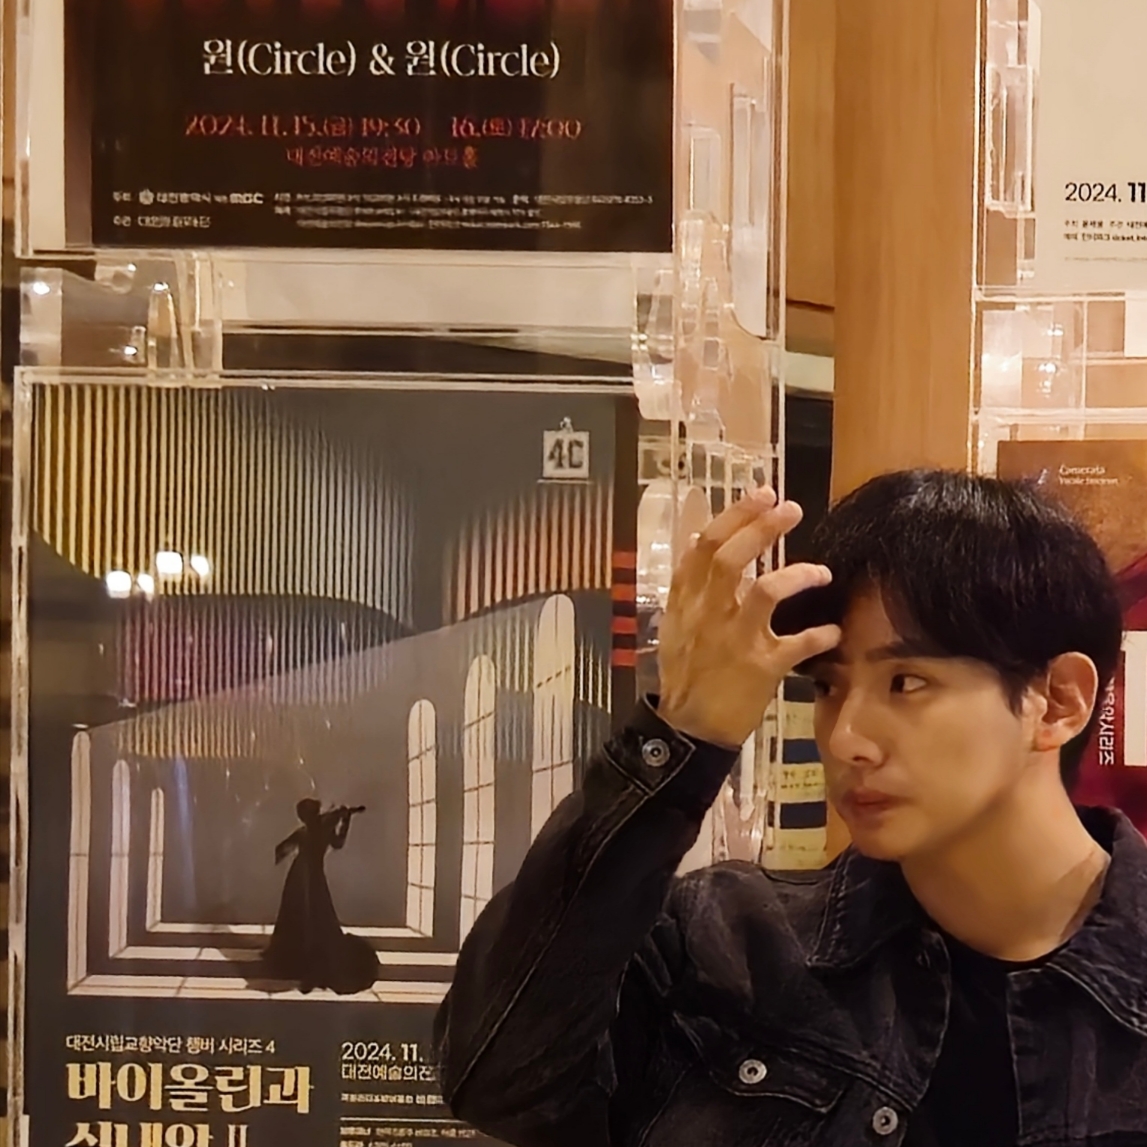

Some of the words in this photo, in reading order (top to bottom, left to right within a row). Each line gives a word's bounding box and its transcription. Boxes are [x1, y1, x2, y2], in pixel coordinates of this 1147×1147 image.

[203, 38, 356, 76] 원(Circle)
[369, 44, 396, 75] &
[406, 40, 561, 79] 원(Circle)
[1064, 182, 1123, 203] 2024.
[65, 1035, 182, 1054] 대전시립교향악단
[186, 1036, 215, 1055] 챔버
[218, 1037, 263, 1056] 시리즈
[264, 1041, 275, 1054] 4
[341, 1041, 396, 1061] 2024.
[400, 1042, 424, 1063] 11.
[65, 1061, 315, 1113] 바이올린과
